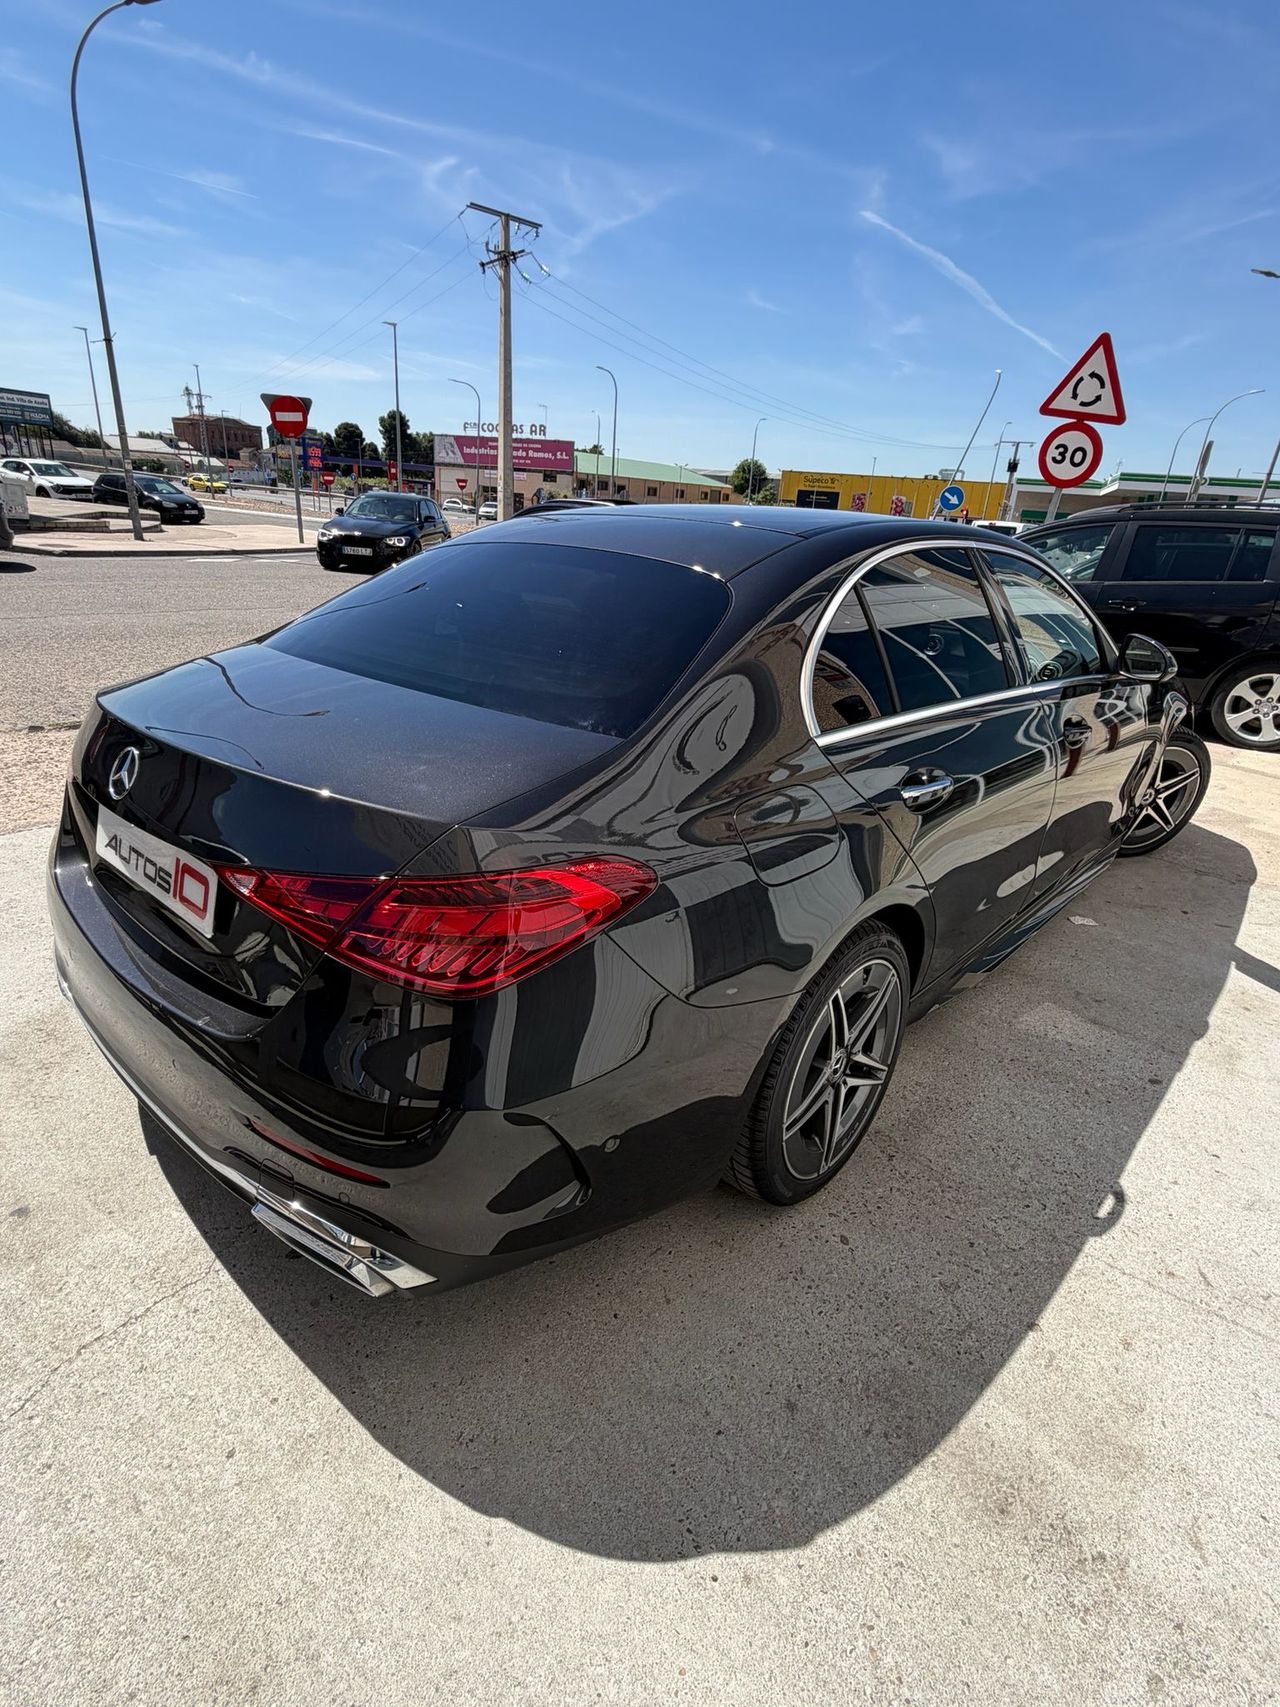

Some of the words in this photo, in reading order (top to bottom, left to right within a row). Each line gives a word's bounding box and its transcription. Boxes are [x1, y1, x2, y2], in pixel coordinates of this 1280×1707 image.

[481, 423, 524, 434] COCAS
[530, 424, 547, 437] AR
[463, 446, 497, 456] Industrias
[1051, 443, 1087, 468] 30
